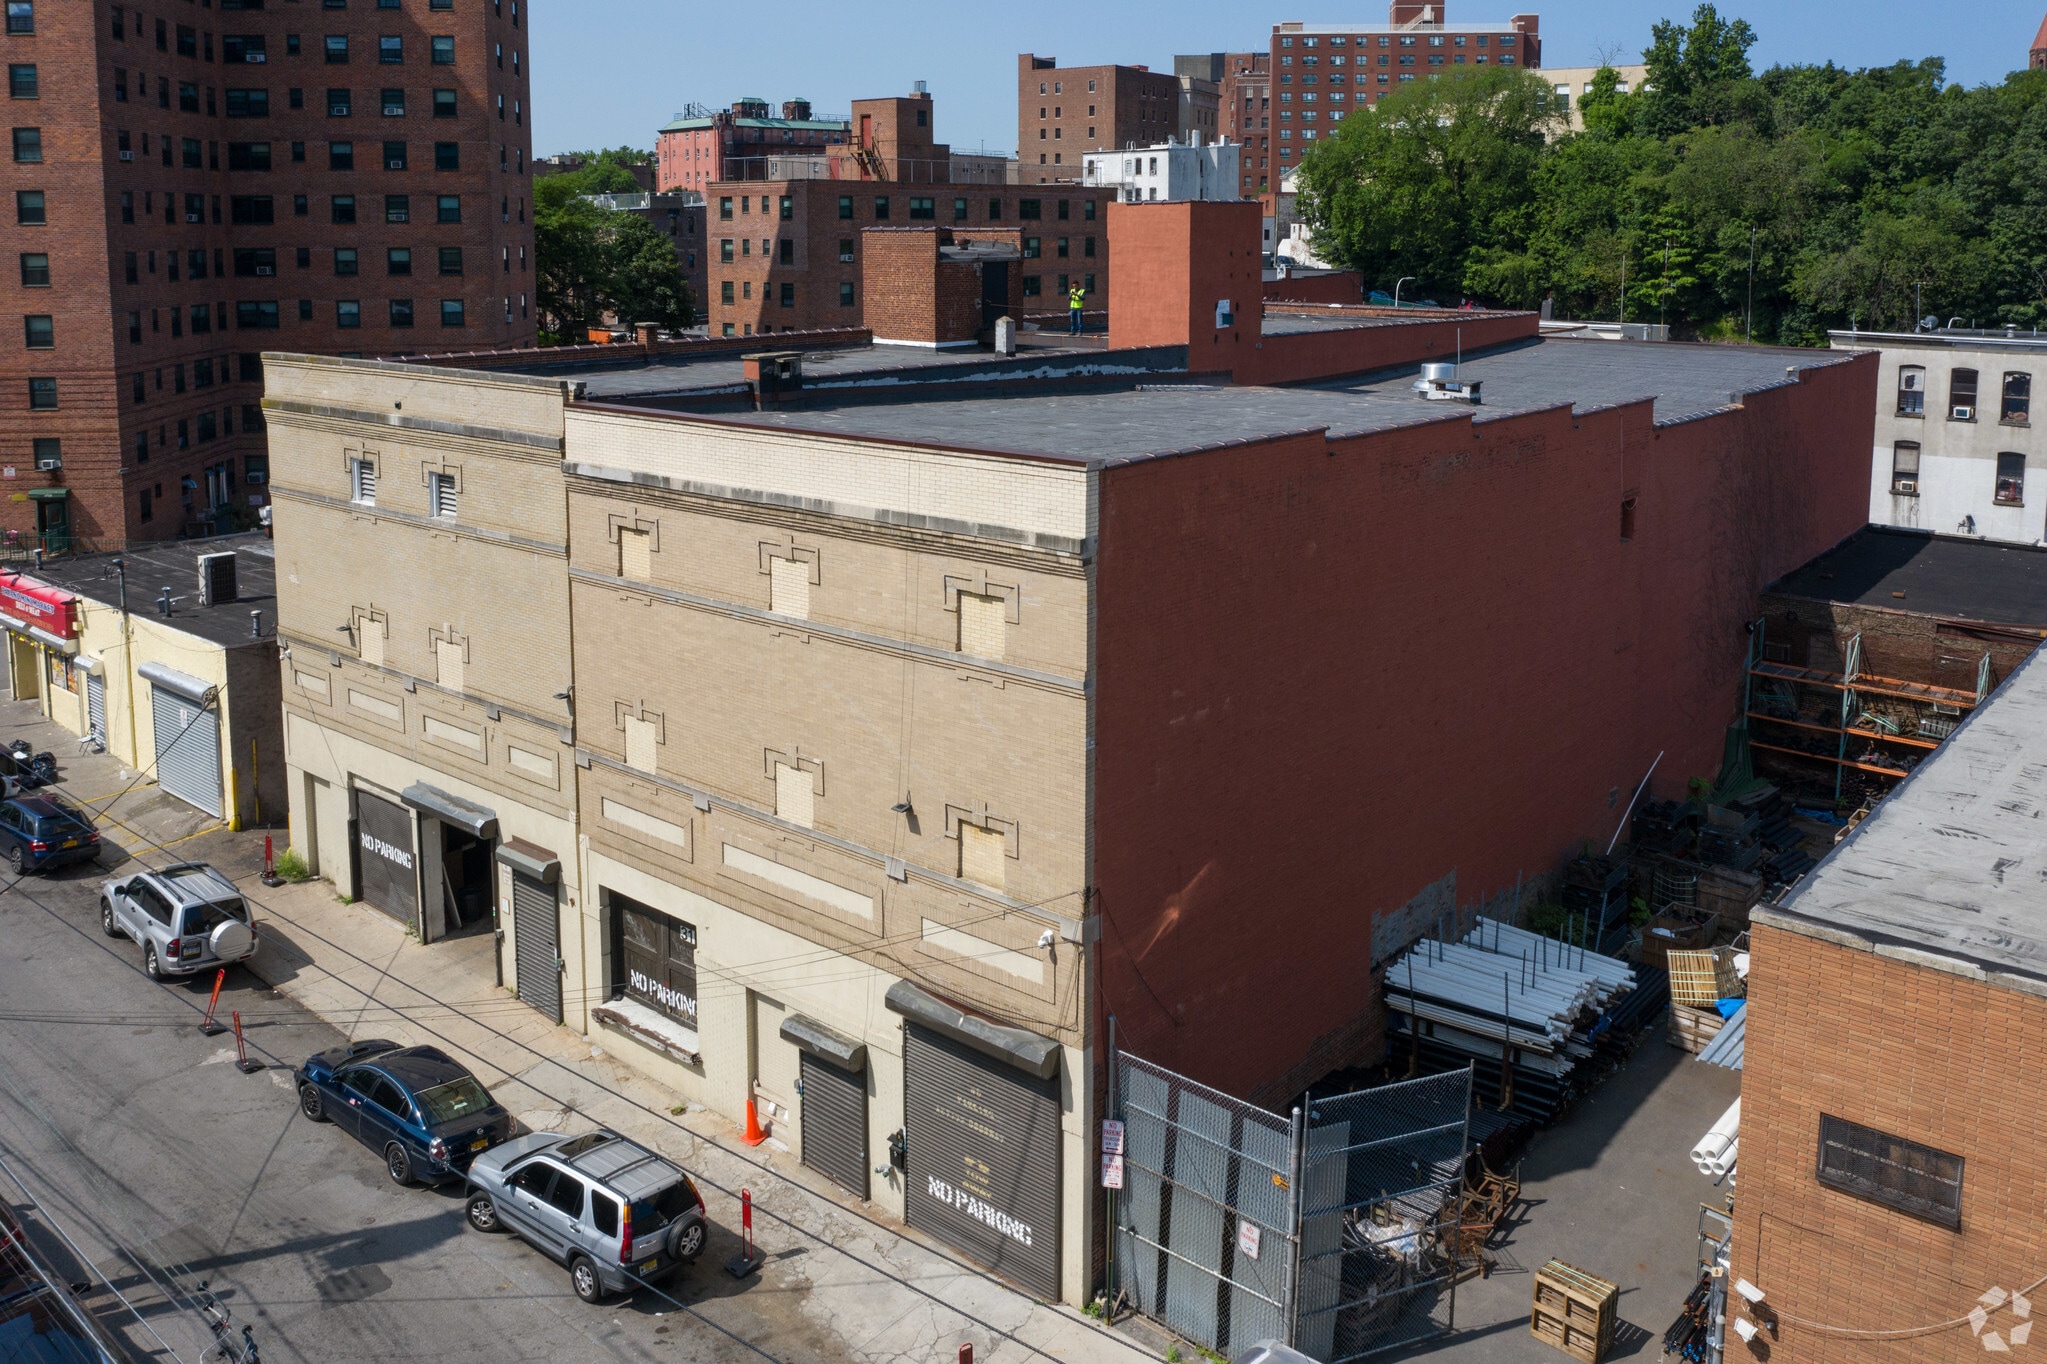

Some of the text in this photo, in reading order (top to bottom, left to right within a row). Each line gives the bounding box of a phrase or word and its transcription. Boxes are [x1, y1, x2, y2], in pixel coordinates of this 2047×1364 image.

[361, 832, 412, 869] NO PARKING
[681, 926, 695, 944] 31
[631, 969, 647, 992] NO
[1103, 1129, 1122, 1138] PARKING
[1103, 1163, 1122, 1172] PARKING
[1109, 1156, 1117, 1164] NO
[928, 1174, 953, 1203] NO
[955, 1188, 1033, 1246] PARKING
